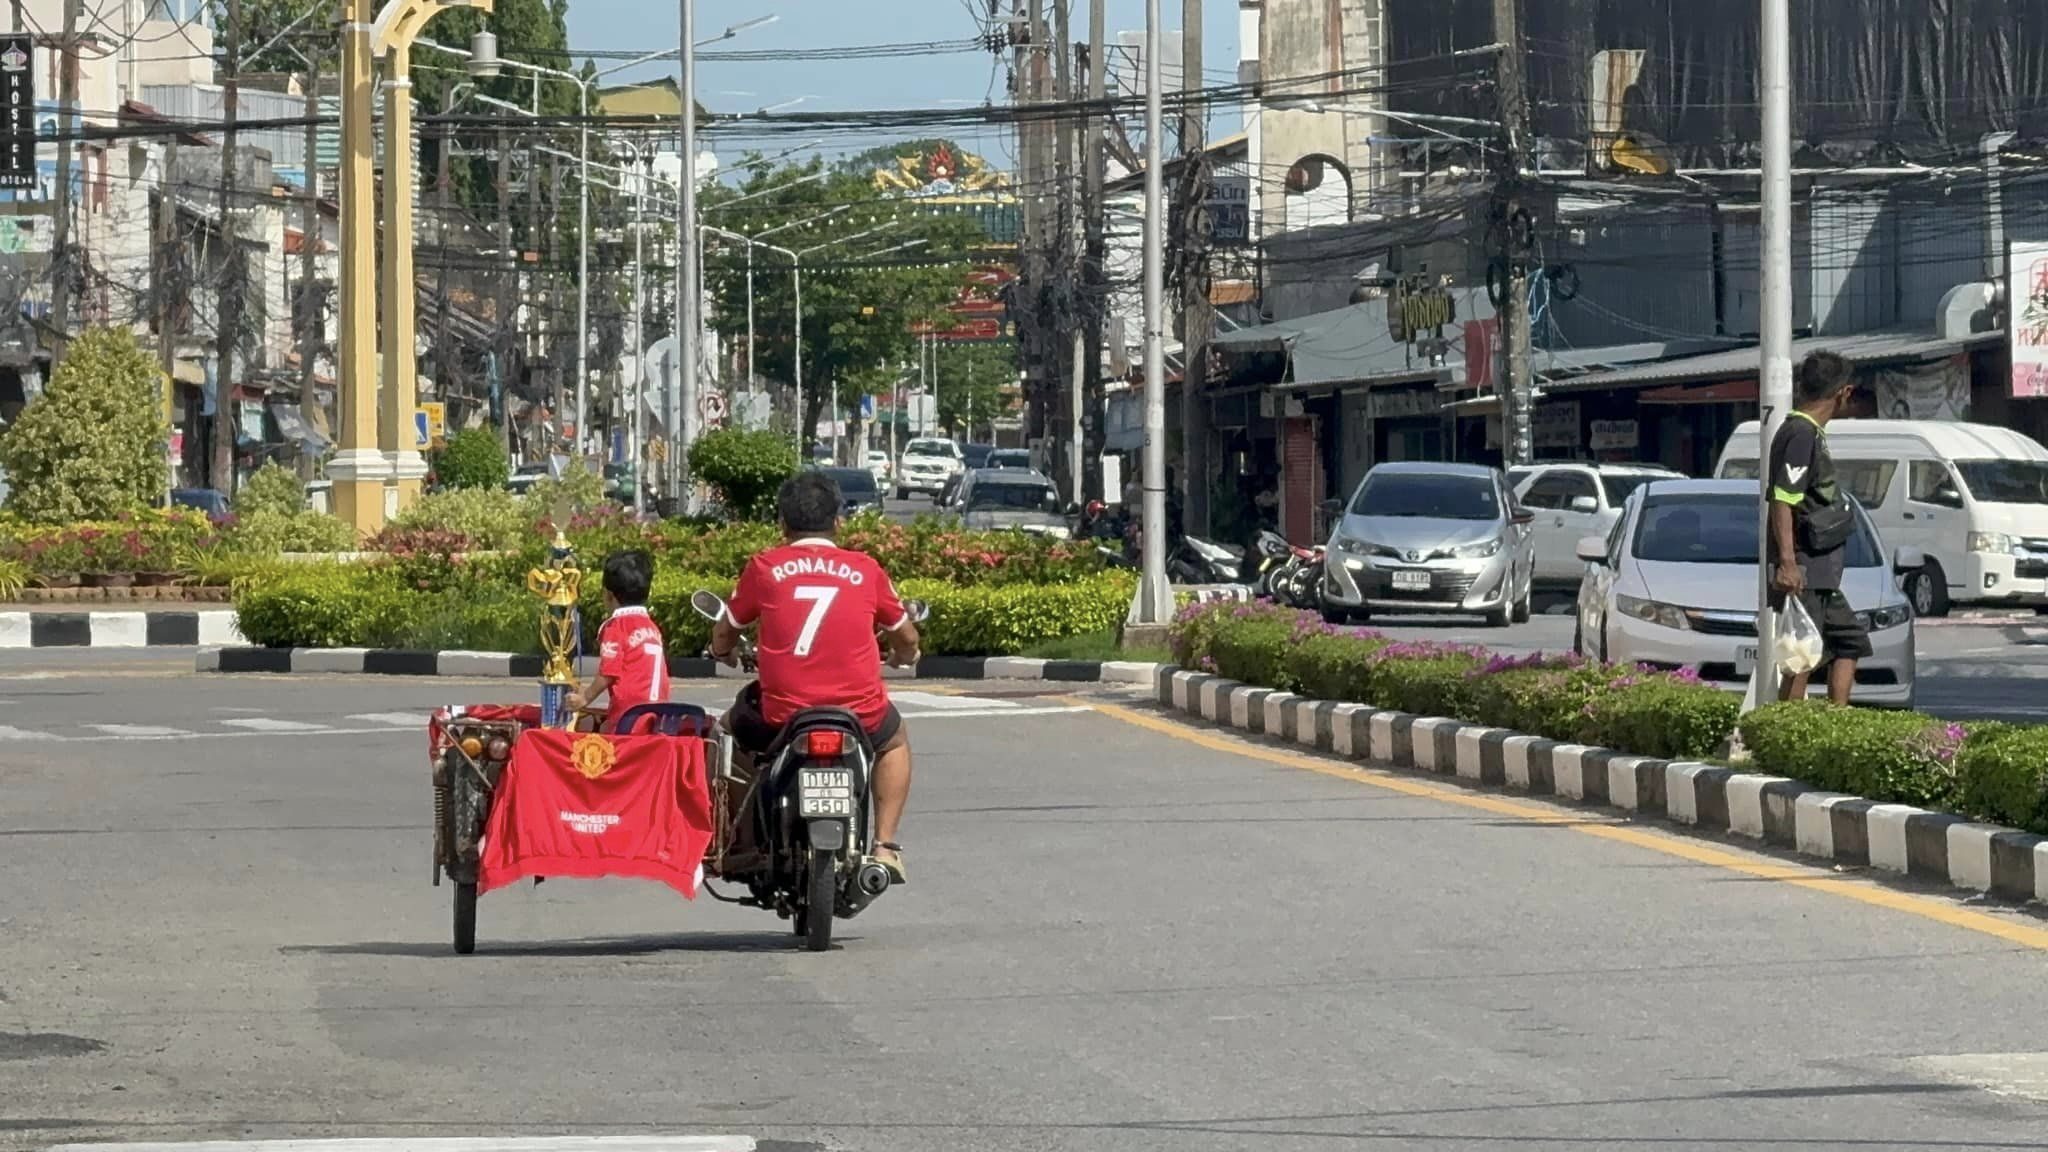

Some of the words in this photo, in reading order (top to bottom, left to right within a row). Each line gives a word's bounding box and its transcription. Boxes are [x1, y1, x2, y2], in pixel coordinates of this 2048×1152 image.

[1762, 405, 1774, 425] 7
[772, 557, 863, 585] RONALDO
[793, 585, 839, 656] 7
[643, 643, 663, 701] 7
[810, 799, 843, 813] 350
[560, 810, 620, 825] MANCHESTER
[572, 822, 607, 834] UNITED
